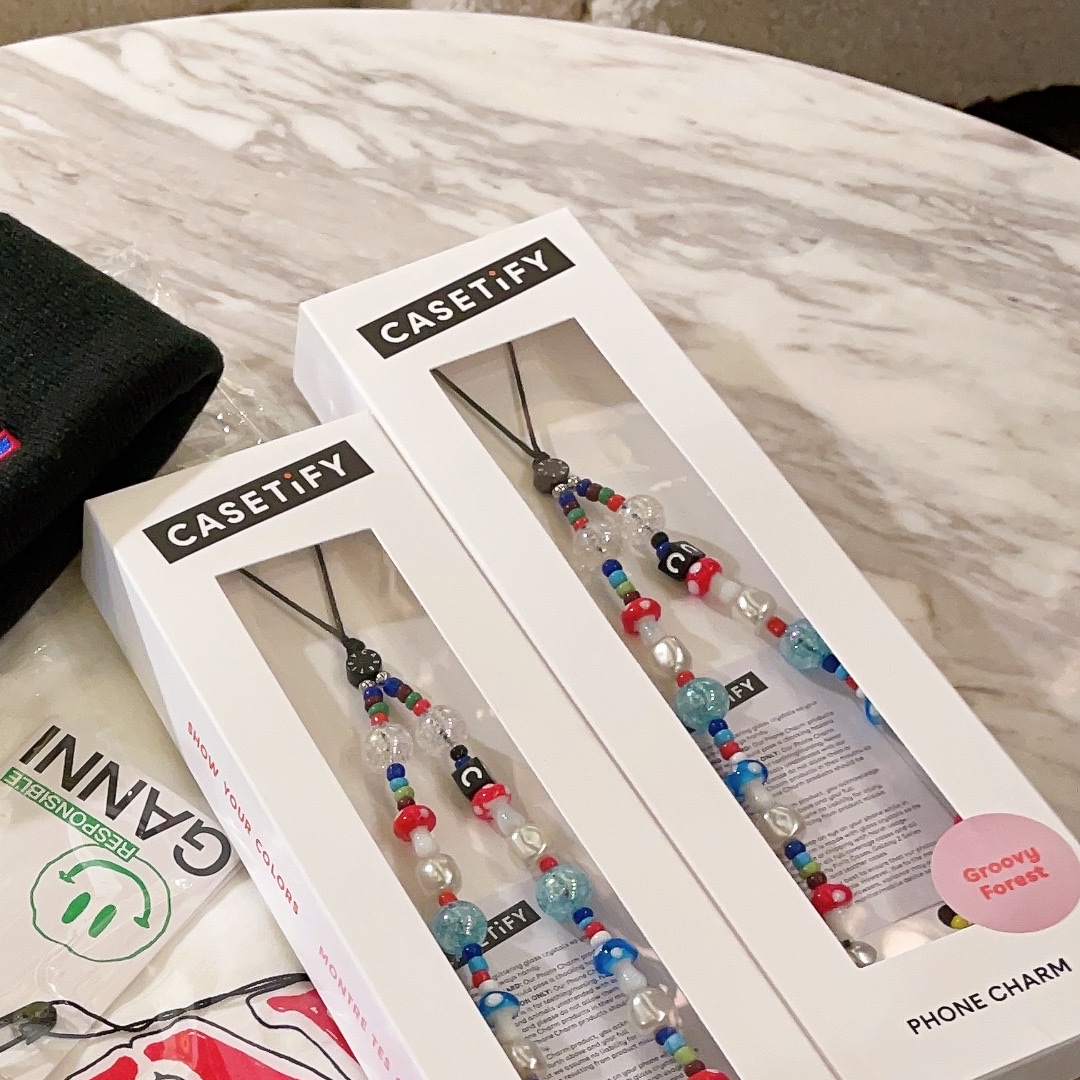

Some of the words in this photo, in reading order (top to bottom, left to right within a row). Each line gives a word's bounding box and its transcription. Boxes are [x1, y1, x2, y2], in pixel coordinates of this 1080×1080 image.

[4, 769, 137, 861] RESPONSIBLE
[19, 725, 231, 877] GANNI
[186, 721, 220, 777] SHOW
[223, 781, 252, 837] YOUR
[255, 838, 299, 915] COLORS
[461, 766, 483, 788] C
[962, 845, 1042, 885] Groovy
[978, 864, 1050, 901] Forest
[318, 945, 368, 1032] MONTRE
[371, 1034, 392, 1072] TES
[905, 993, 989, 1036] PHONE
[986, 957, 1073, 1003] CHARM
